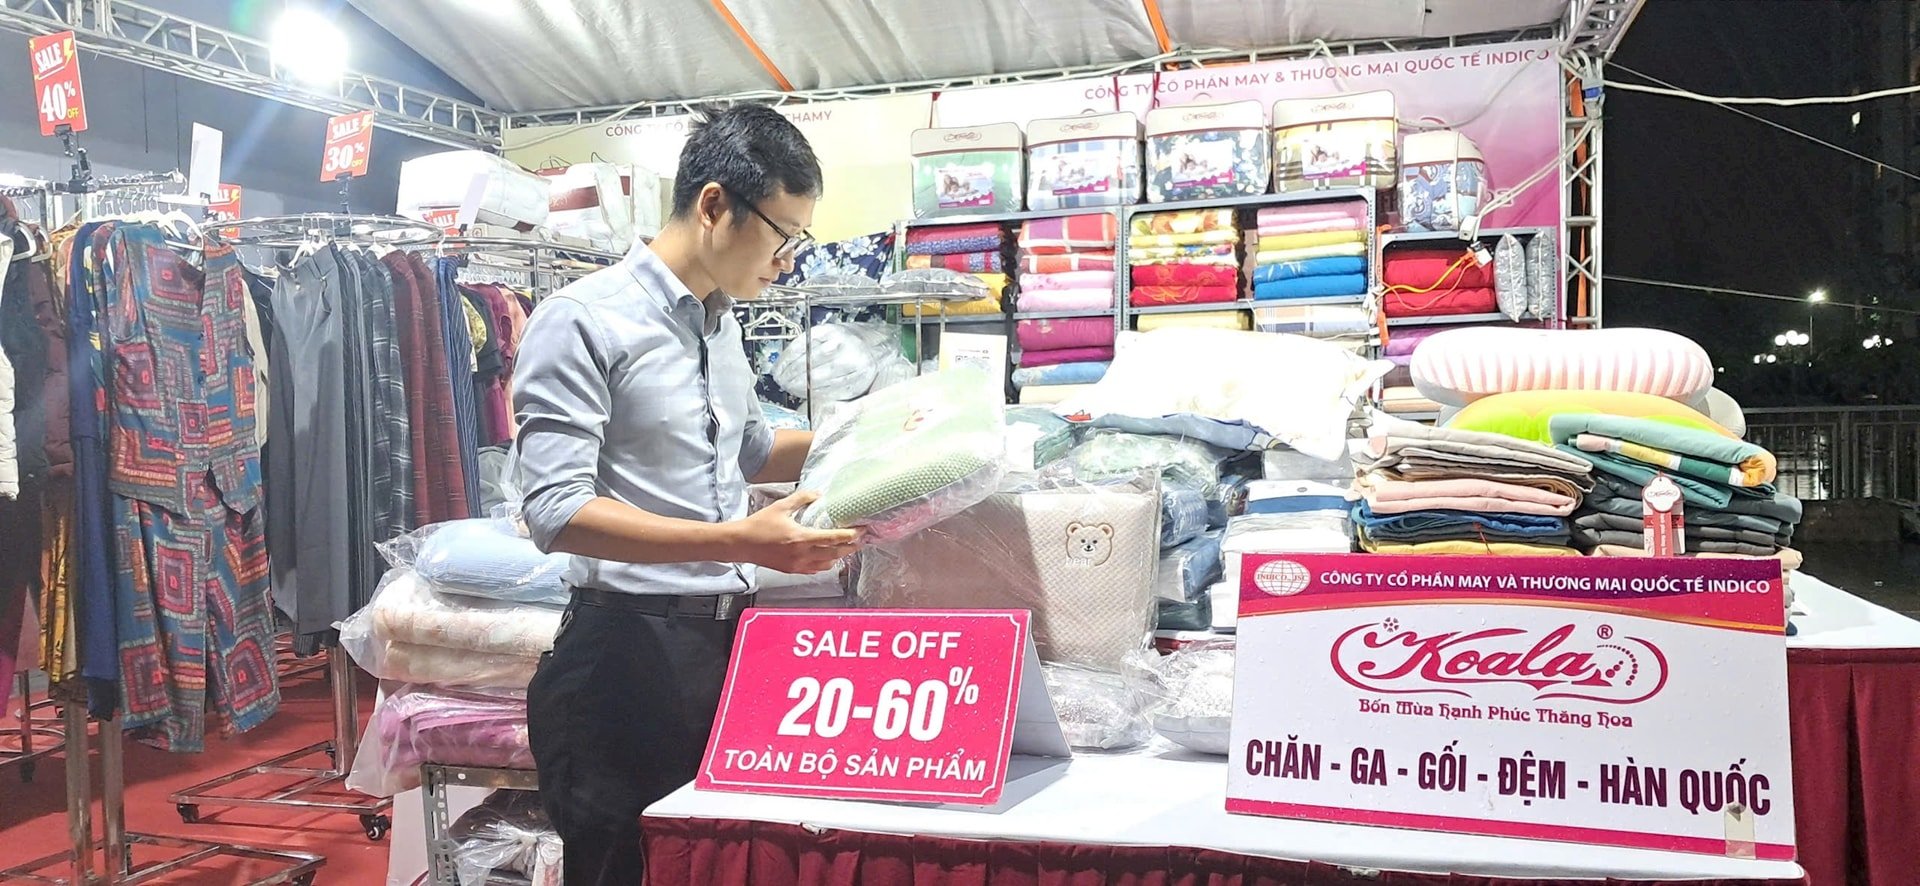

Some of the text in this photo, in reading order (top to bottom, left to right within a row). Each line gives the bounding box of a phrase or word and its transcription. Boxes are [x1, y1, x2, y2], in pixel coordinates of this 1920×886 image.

[35, 42, 63, 73] SALE
[1085, 84, 1129, 100] CÔNG
[1134, 84, 1152, 96] TY
[1235, 73, 1269, 86] MAY
[1275, 71, 1285, 83] &
[1367, 62, 1398, 78] MẠI
[1404, 53, 1455, 74] QUỐC
[1460, 50, 1481, 67] TẾ
[41, 81, 76, 121] 40%
[67, 107, 79, 119] OFF
[332, 118, 360, 139] SALE
[605, 123, 642, 137] CÔNG
[325, 142, 365, 172] 30%
[1320, 571, 1362, 586] CÔNG
[1365, 573, 1384, 587] TY
[1387, 570, 1408, 587] CỔ
[1458, 575, 1490, 589] MAY
[1496, 573, 1517, 589] VÀ
[1520, 575, 1591, 591] THƯƠNG
[1595, 578, 1626, 595] MẠI
[1630, 575, 1681, 593] QUỐC
[1683, 575, 1704, 593] TẾ
[1708, 579, 1770, 594] INDICO
[793, 630, 961, 659] SALE OFF
[1358, 624, 1598, 684] Koala
[777, 666, 979, 741] 20-60%
[1359, 698, 1390, 714] Bốn
[1487, 706, 1531, 722] Phúc
[1535, 708, 1592, 728] Thăng
[724, 744, 986, 781] TOÀN BỘ SẢN PHẨM
[1246, 734, 1321, 781] CHĂN
[1350, 747, 1388, 786] GA
[1418, 740, 1467, 792] GỐI
[1498, 750, 1566, 806] ĐỆM
[1600, 757, 1667, 808] HÀN
[1679, 758, 1771, 816] QUỐC
